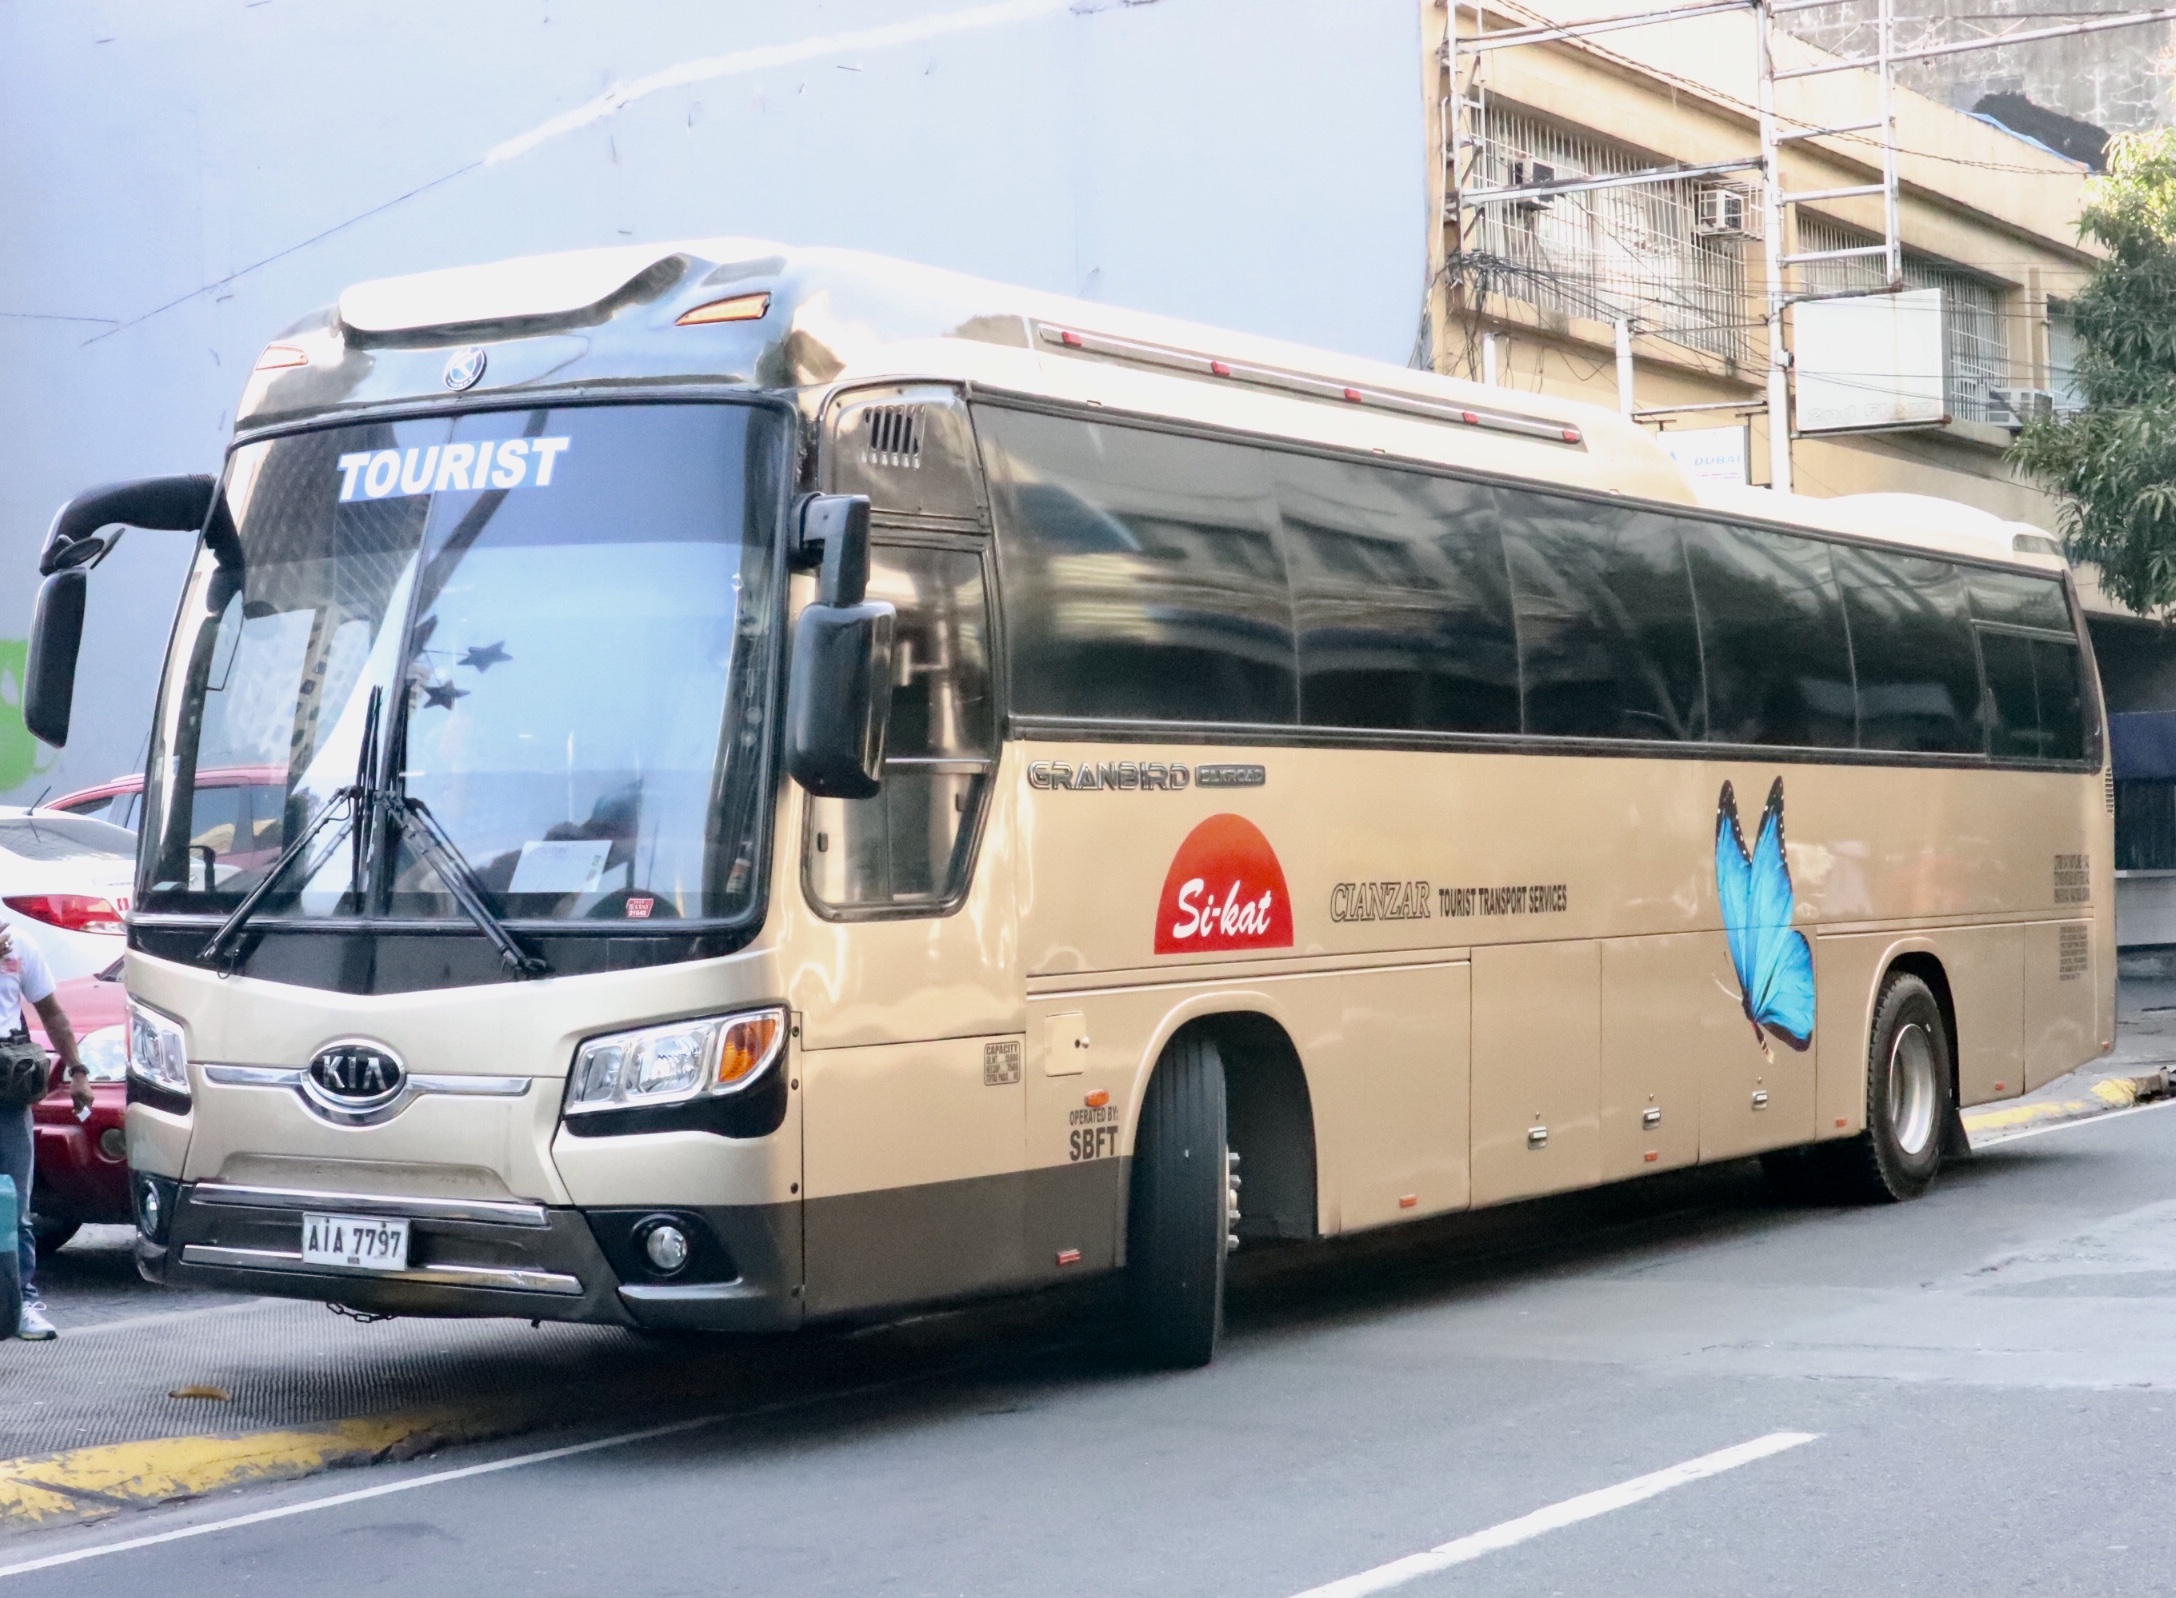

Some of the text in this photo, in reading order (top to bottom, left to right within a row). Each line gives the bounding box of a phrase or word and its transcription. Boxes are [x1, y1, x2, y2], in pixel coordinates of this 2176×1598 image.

[1807, 401, 1932, 422] 2nd Floor
[338, 436, 570, 500] TOURIST
[1694, 454, 1741, 466] DUBAI
[1027, 760, 1190, 791] GRANBIRD
[1172, 877, 1272, 939] Si-kat
[1330, 880, 1567, 923] CIANZAR TOURIST TRANSPORT SERVICES
[986, 1044, 1018, 1056] CAPACITY
[322, 1055, 387, 1090] KIA
[1069, 1106, 1106, 1126] OPERATED
[1069, 1125, 1119, 1162] SBFT
[308, 1224, 402, 1258] AIA 7797
